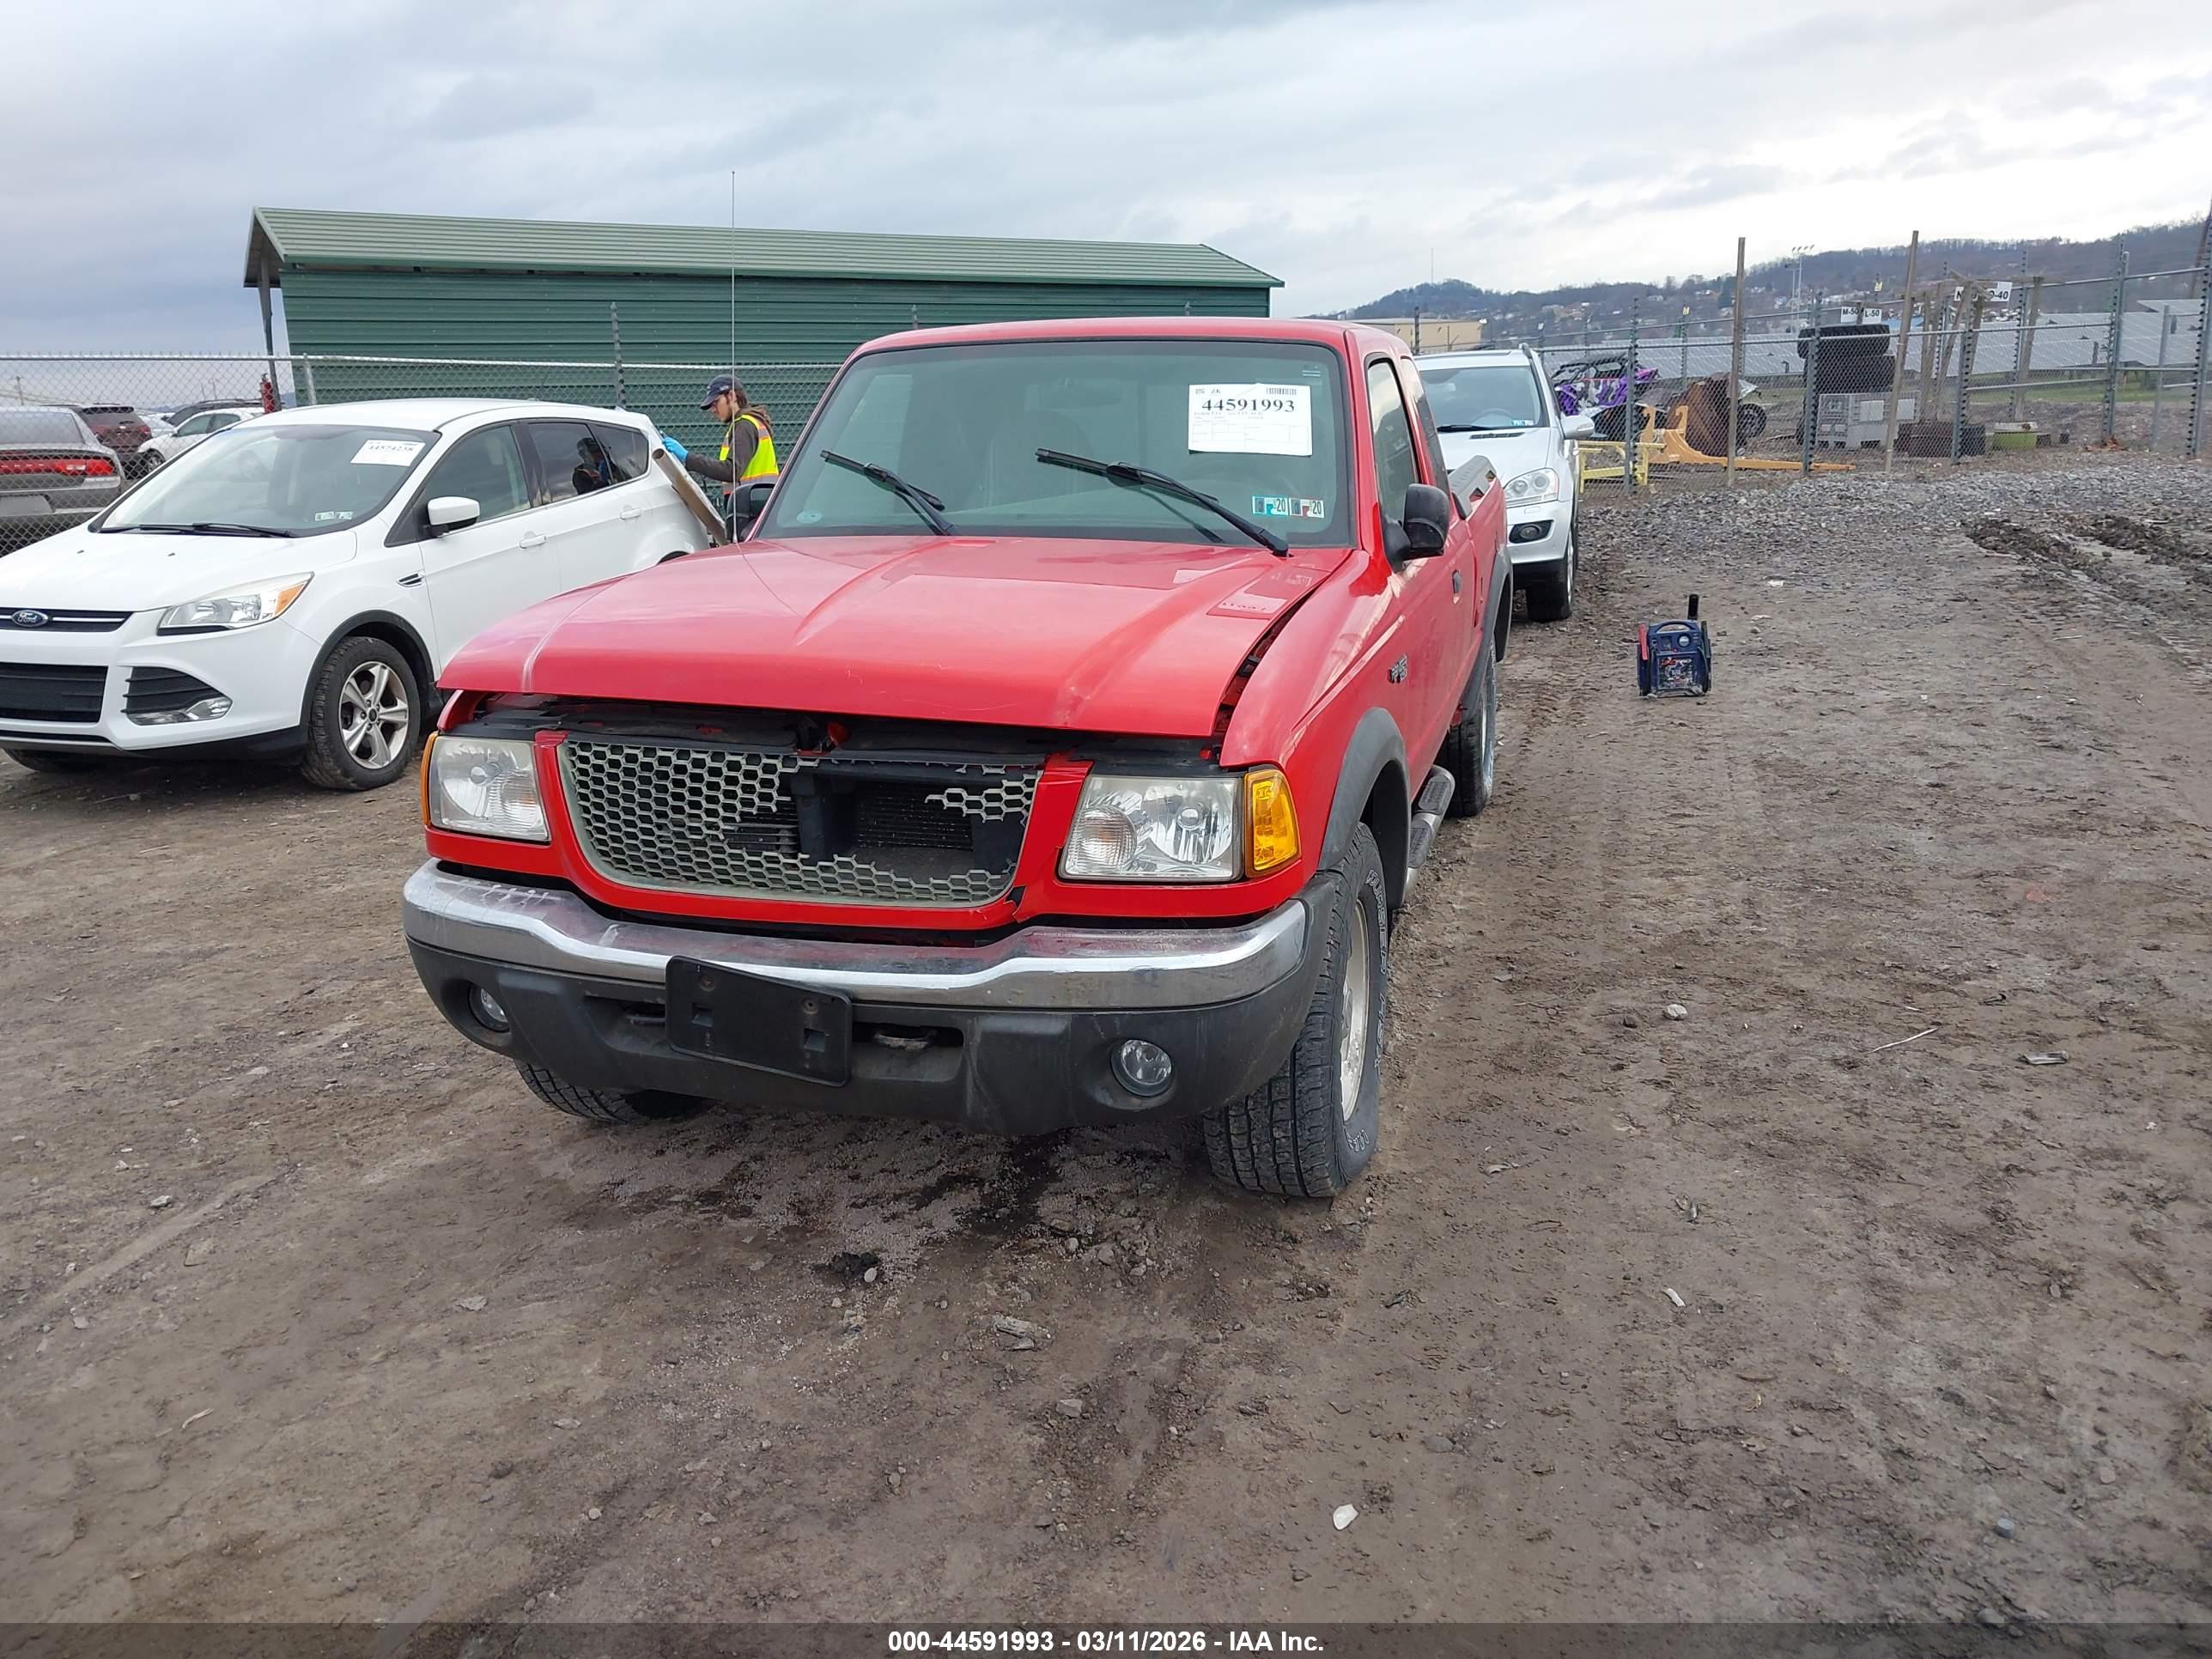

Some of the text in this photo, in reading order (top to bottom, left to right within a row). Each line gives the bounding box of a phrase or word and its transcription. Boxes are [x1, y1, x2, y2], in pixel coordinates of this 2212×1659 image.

[1842, 307, 1860, 316] M-50
[1864, 309, 1880, 318] L-50
[1201, 398, 1295, 413] 44591993
